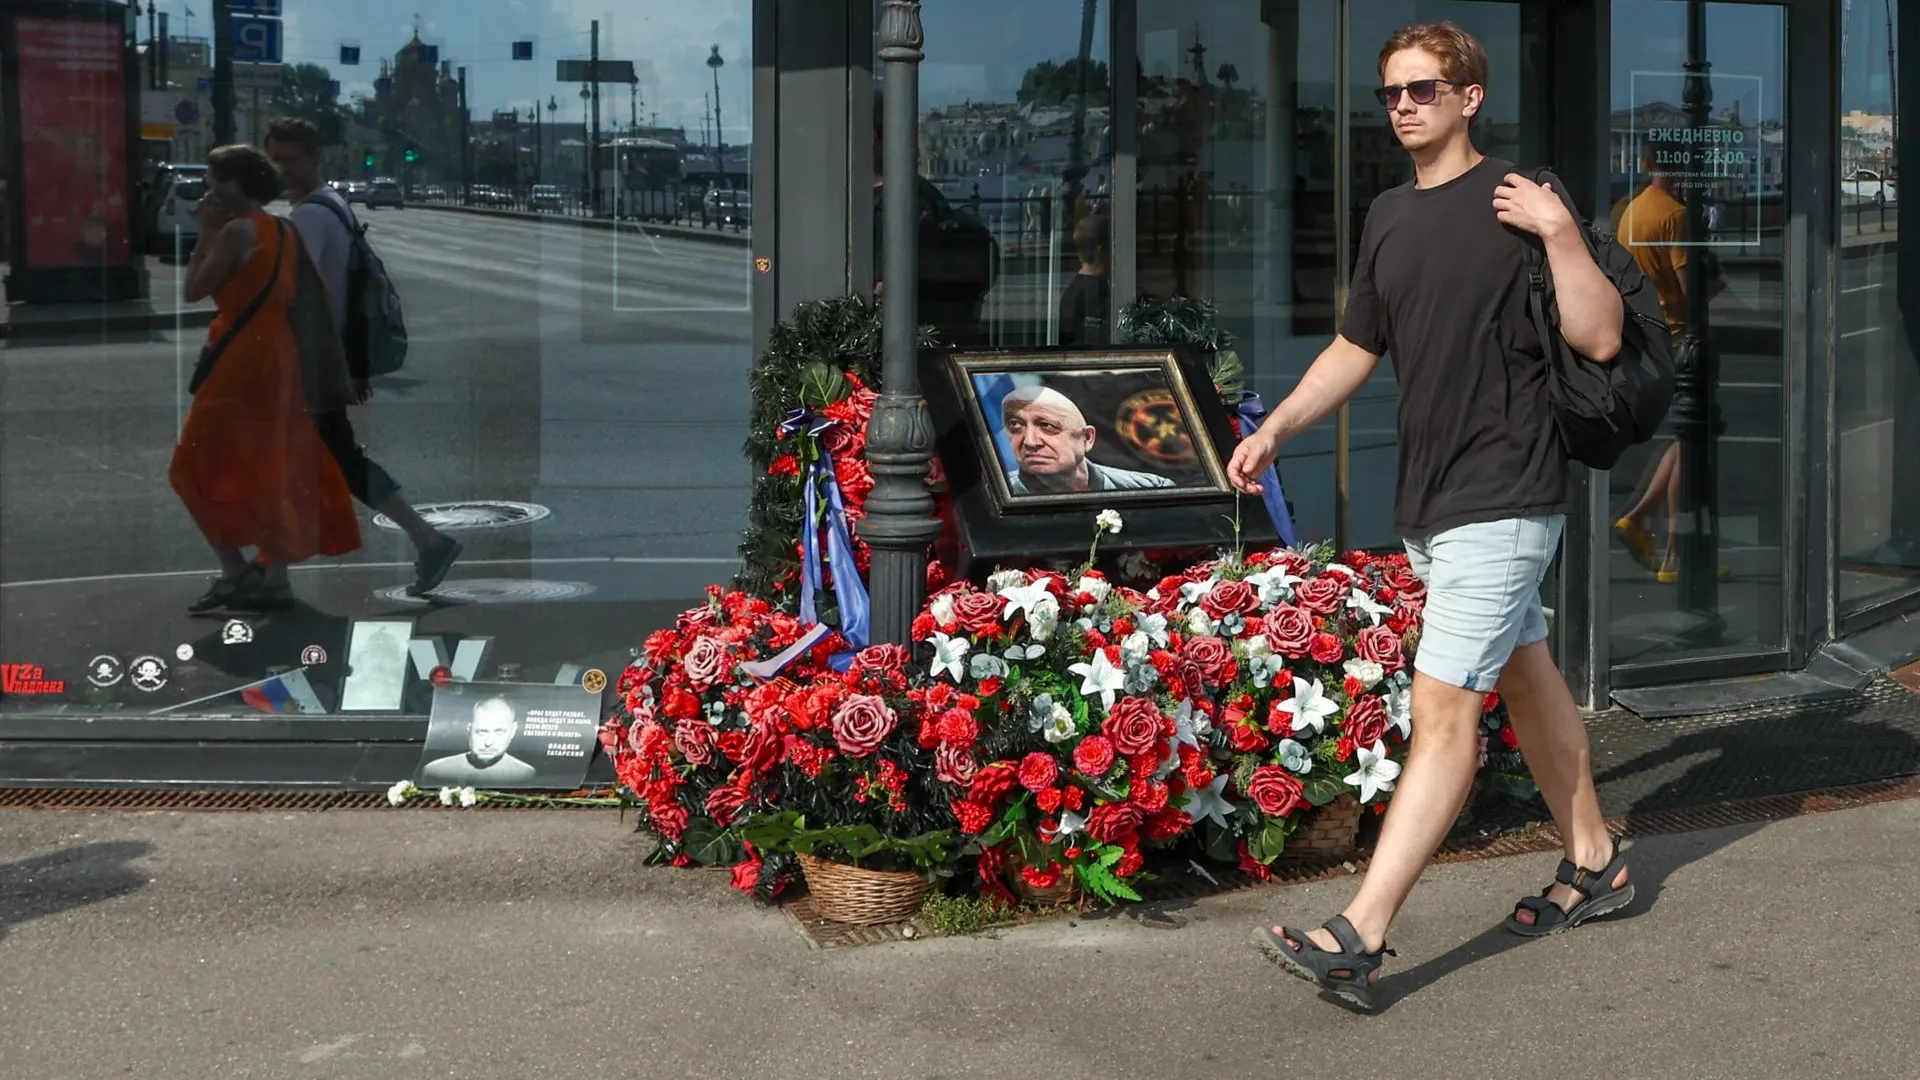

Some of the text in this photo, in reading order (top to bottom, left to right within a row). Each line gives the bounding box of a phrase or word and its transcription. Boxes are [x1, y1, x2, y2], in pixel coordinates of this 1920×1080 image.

[1648, 128, 1744, 144] ЕЖЕДНЕВНО
[1656, 150, 1691, 164] 11:00
[547, 750, 584, 758] ТАТАРСКИЙ
